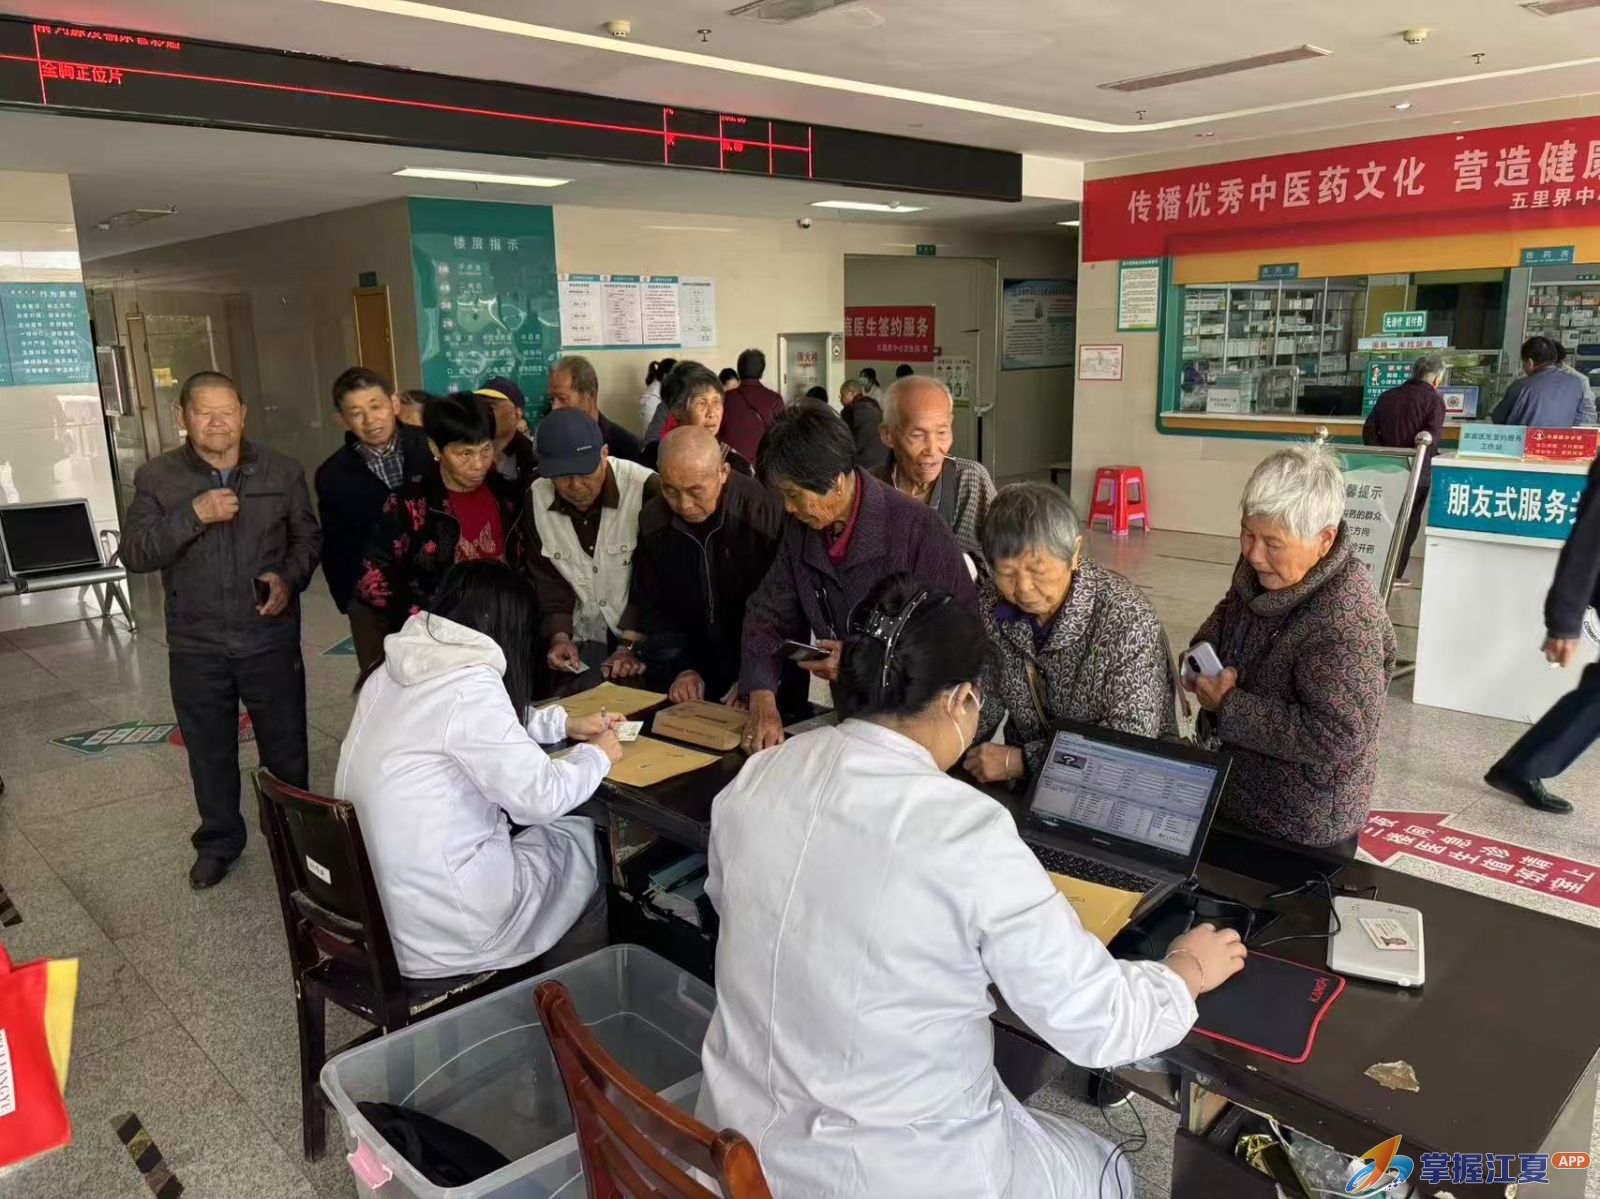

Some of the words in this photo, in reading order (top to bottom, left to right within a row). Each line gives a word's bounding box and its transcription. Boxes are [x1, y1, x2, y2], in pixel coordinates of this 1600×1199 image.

[1127, 156, 1425, 224] 传播优秀中医药文化
[1509, 186, 1600, 209] 五里界中
[453, 235, 519, 251] 楼层指示
